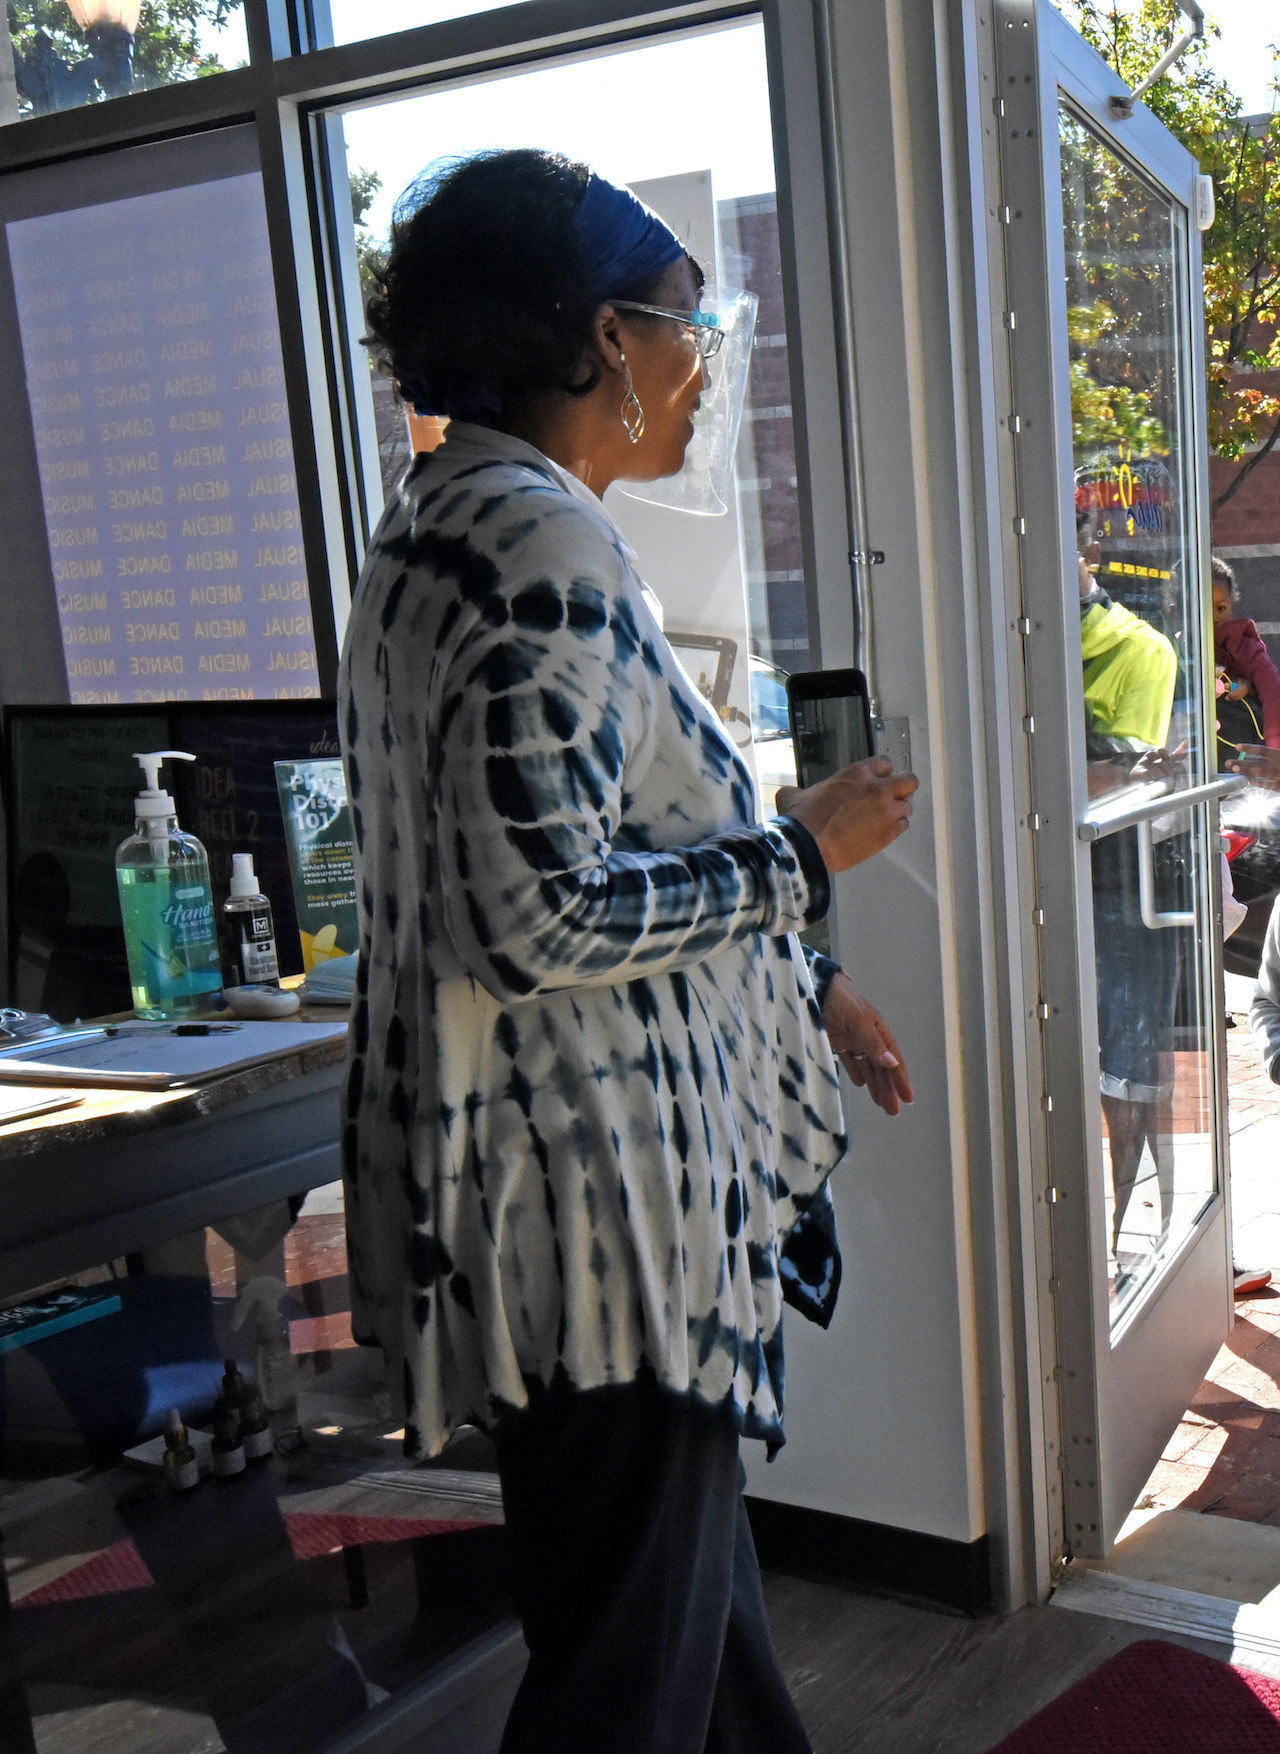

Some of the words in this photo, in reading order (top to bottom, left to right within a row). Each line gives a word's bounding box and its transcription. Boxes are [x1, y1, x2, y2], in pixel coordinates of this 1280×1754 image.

[295, 811, 329, 831] 101
[327, 861, 352, 869] keeps
[303, 870, 342, 878] resources
[303, 878, 327, 886] those
[307, 900, 330, 908] mass
[161, 901, 214, 926] Hand
